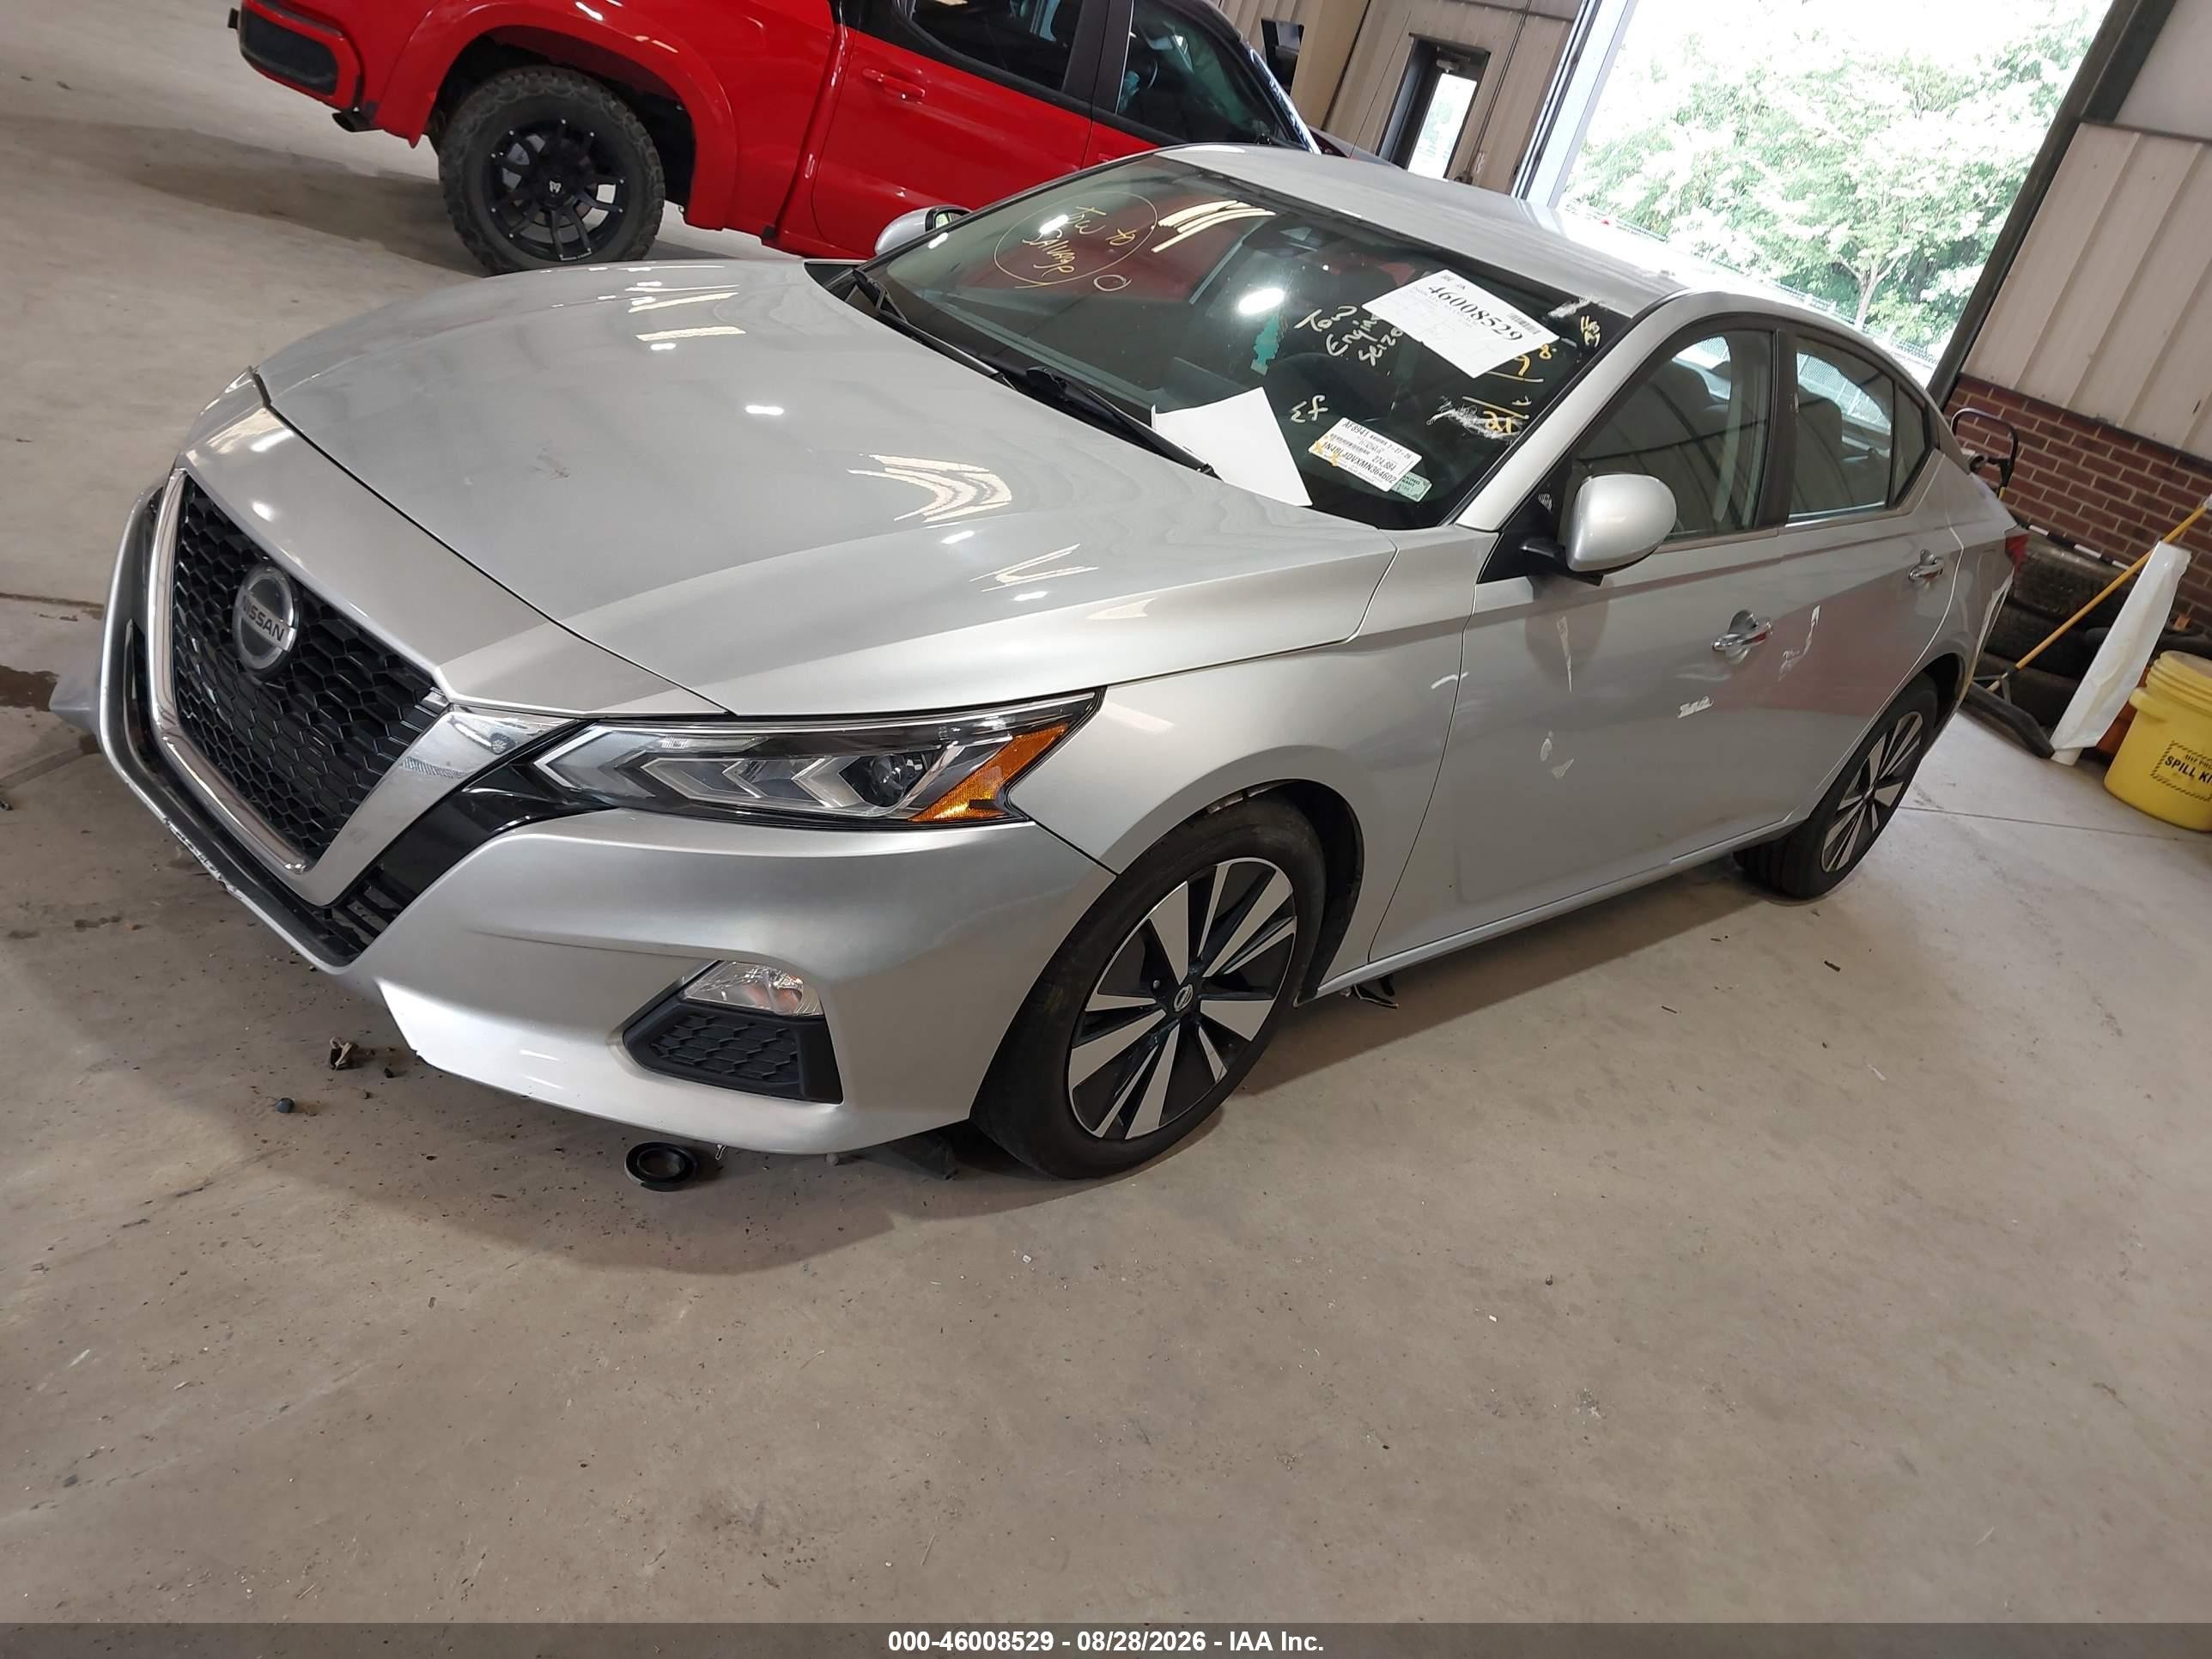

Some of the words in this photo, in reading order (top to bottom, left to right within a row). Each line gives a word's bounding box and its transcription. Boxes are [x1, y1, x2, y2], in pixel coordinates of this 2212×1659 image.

[1428, 286, 1523, 342] 46008529
[242, 594, 285, 641] NISSAN
[2165, 755, 2196, 778] SPILL
